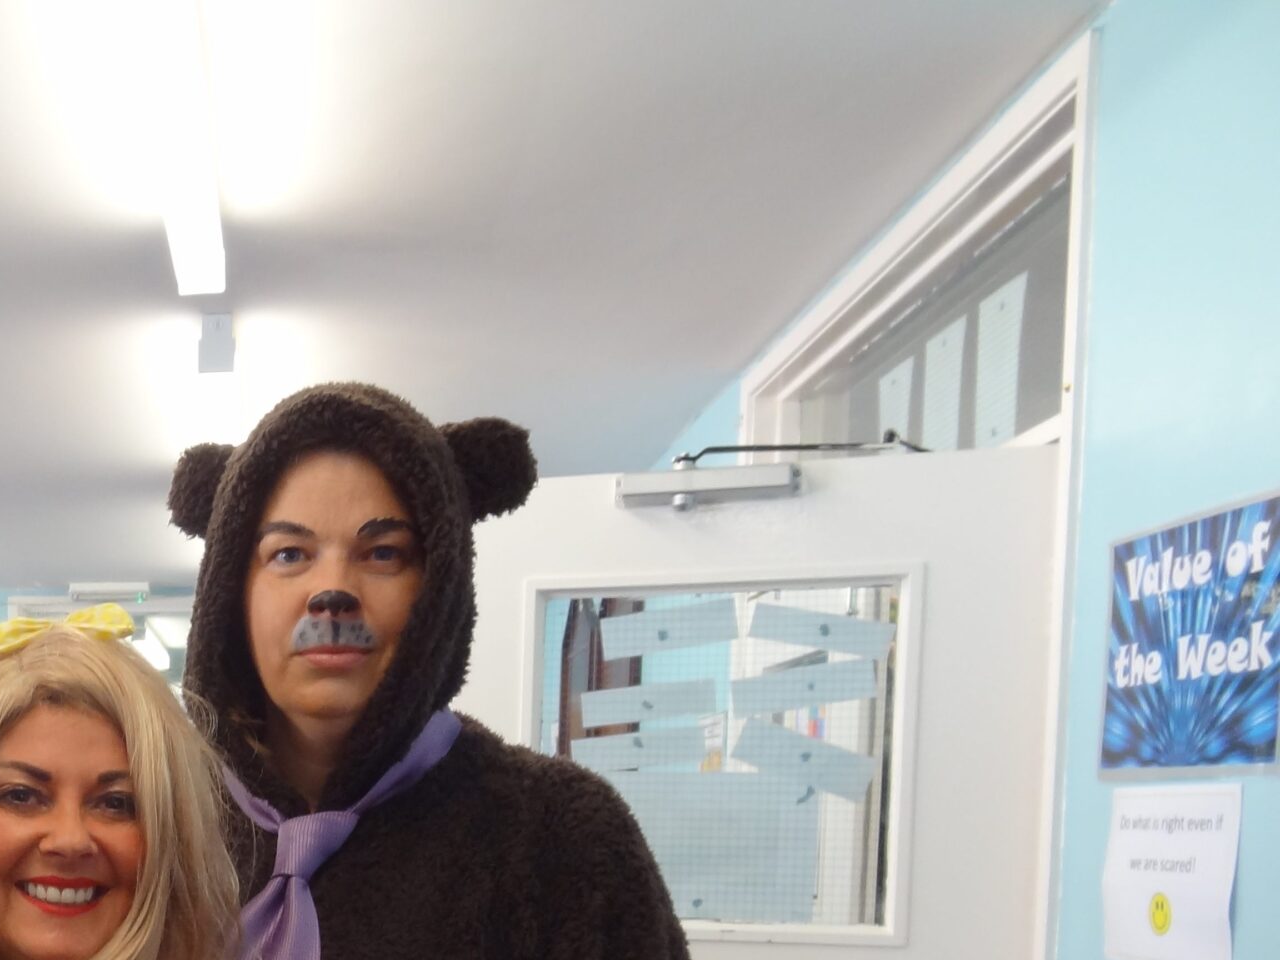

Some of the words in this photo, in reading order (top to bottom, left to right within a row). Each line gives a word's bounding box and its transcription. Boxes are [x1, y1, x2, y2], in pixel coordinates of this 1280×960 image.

[1126, 547, 1212, 600] Value
[1226, 519, 1272, 577] of
[1114, 642, 1162, 688] the
[1177, 620, 1274, 680] Week
[1161, 815, 1185, 835] right
[1187, 818, 1213, 832] even
[1143, 859, 1158, 872] are
